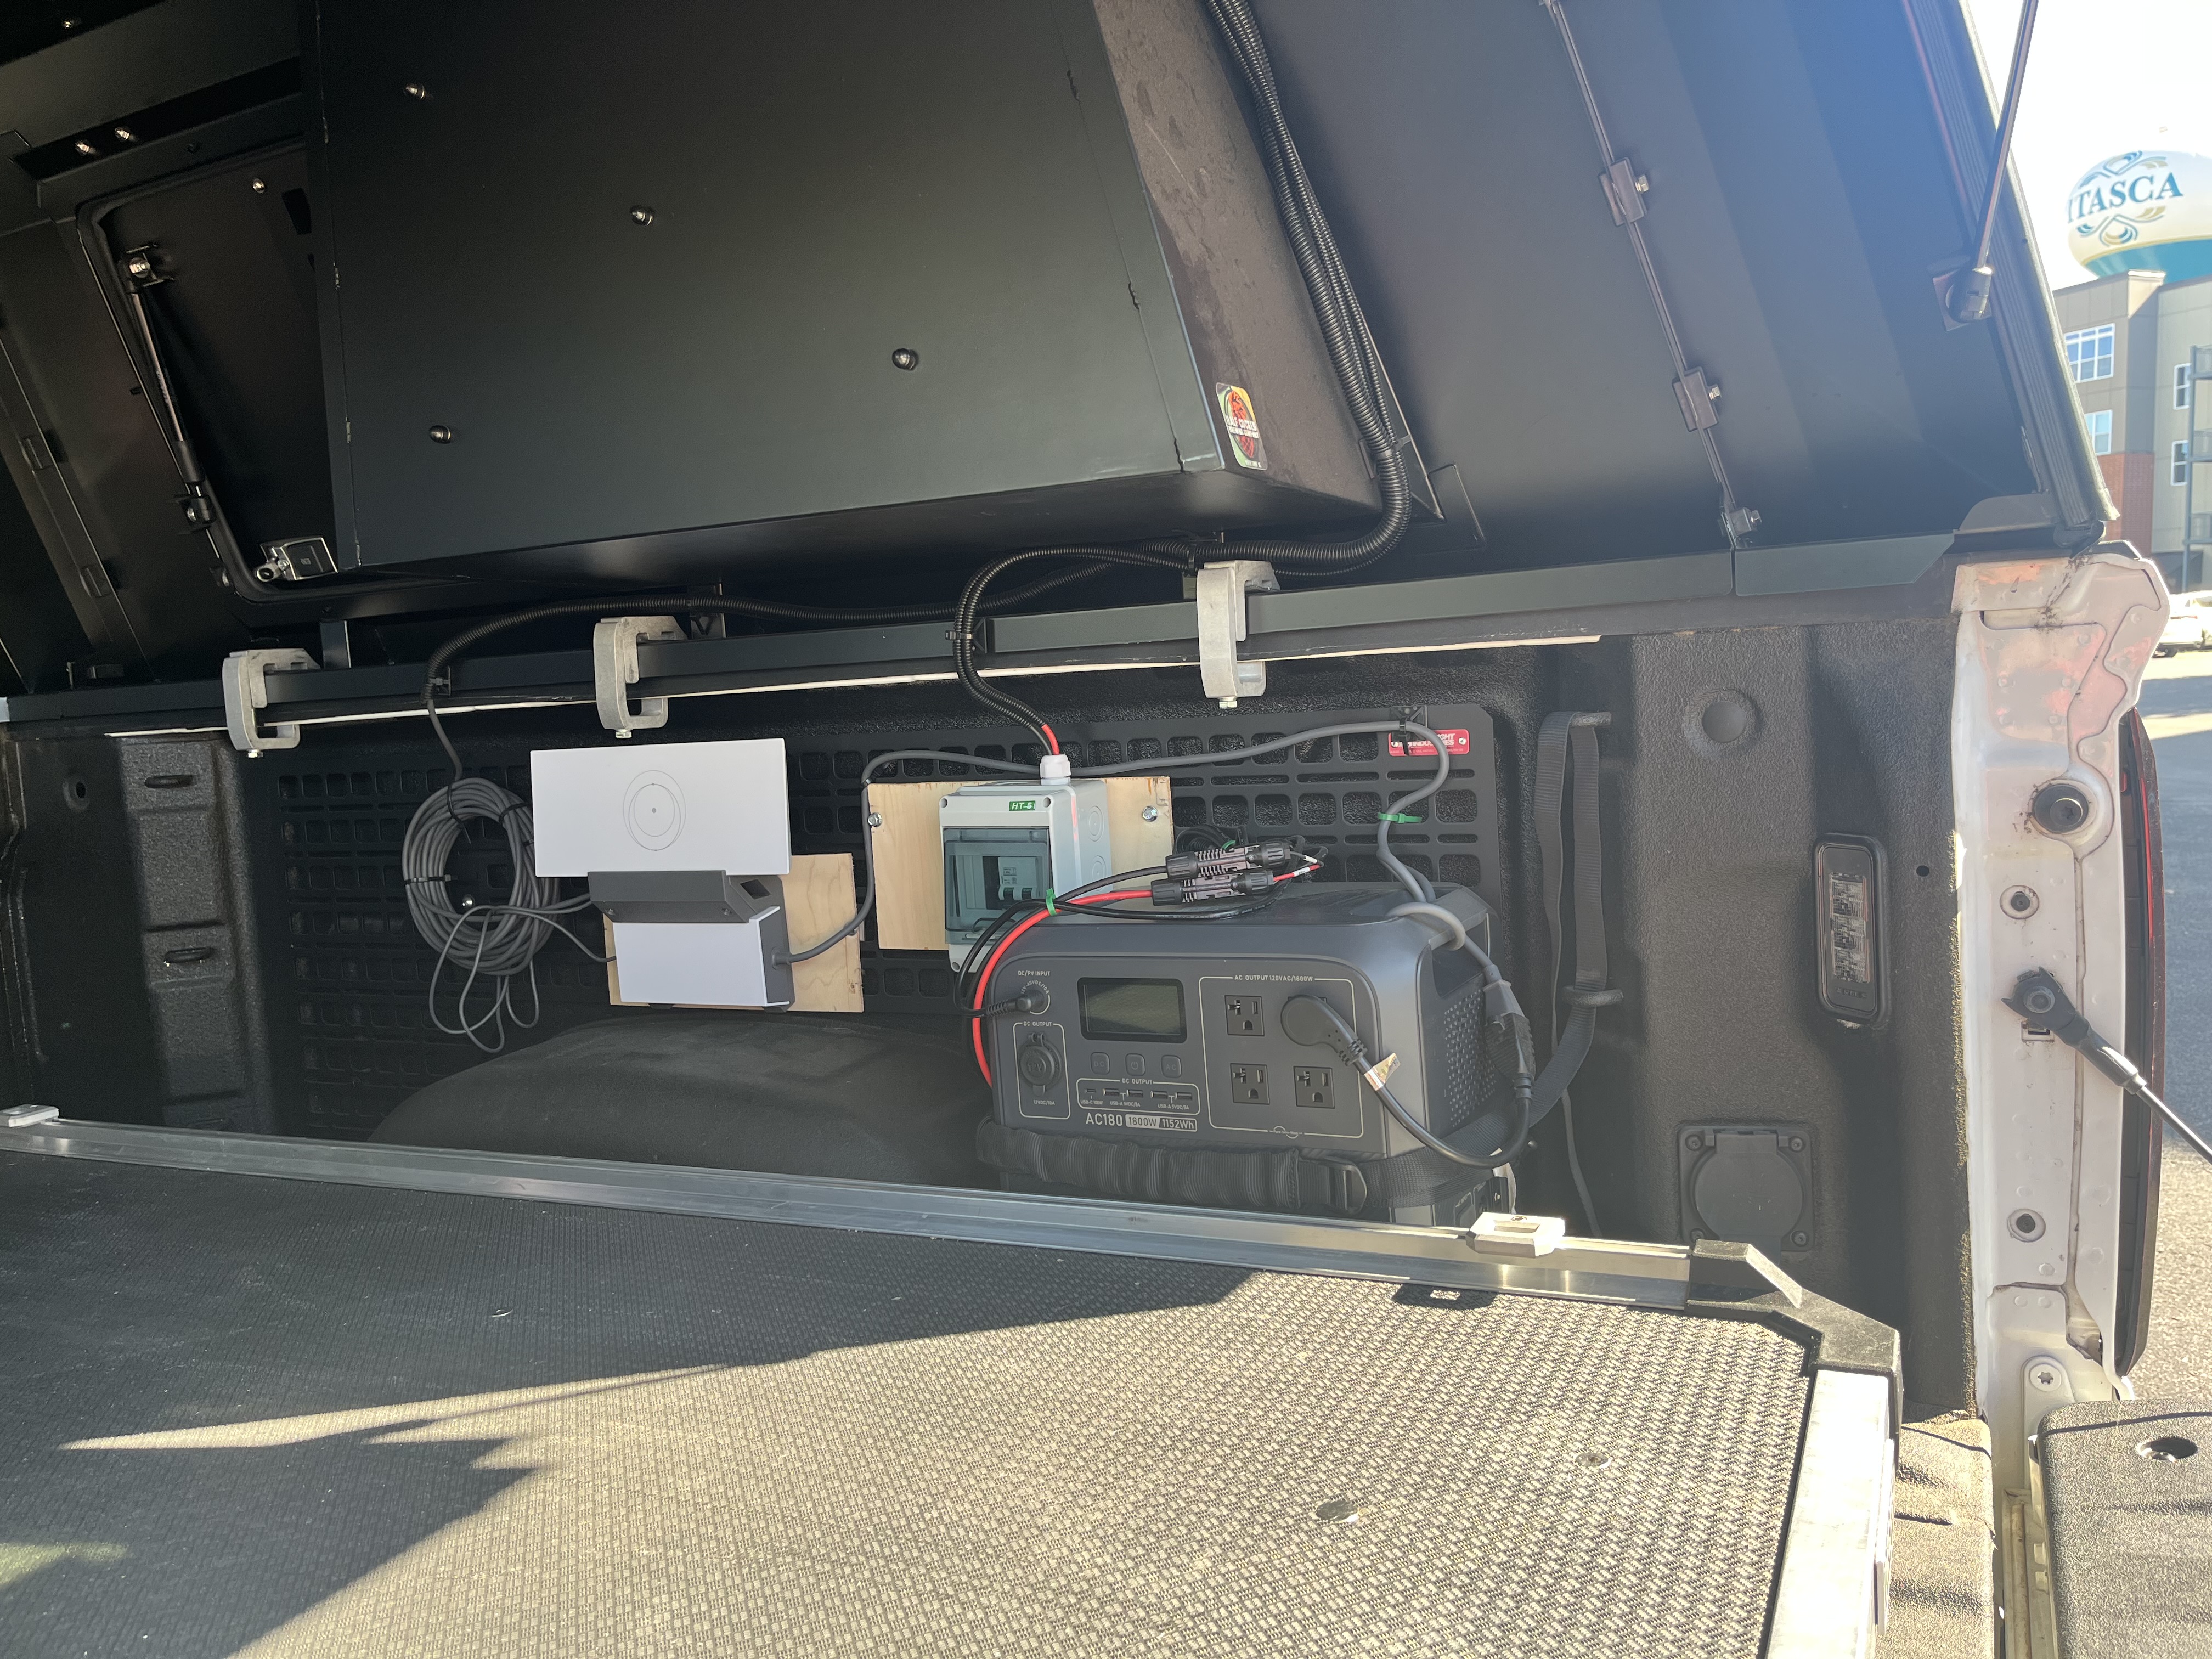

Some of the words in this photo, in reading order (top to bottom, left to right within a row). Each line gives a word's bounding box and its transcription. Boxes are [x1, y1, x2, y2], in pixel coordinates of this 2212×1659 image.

[2067, 172, 2183, 223] ITASCA
[1086, 1113, 1123, 1126] AC180
[1128, 1116, 1158, 1126] 1800W
[1162, 1119, 1194, 1130] 1152Wh
